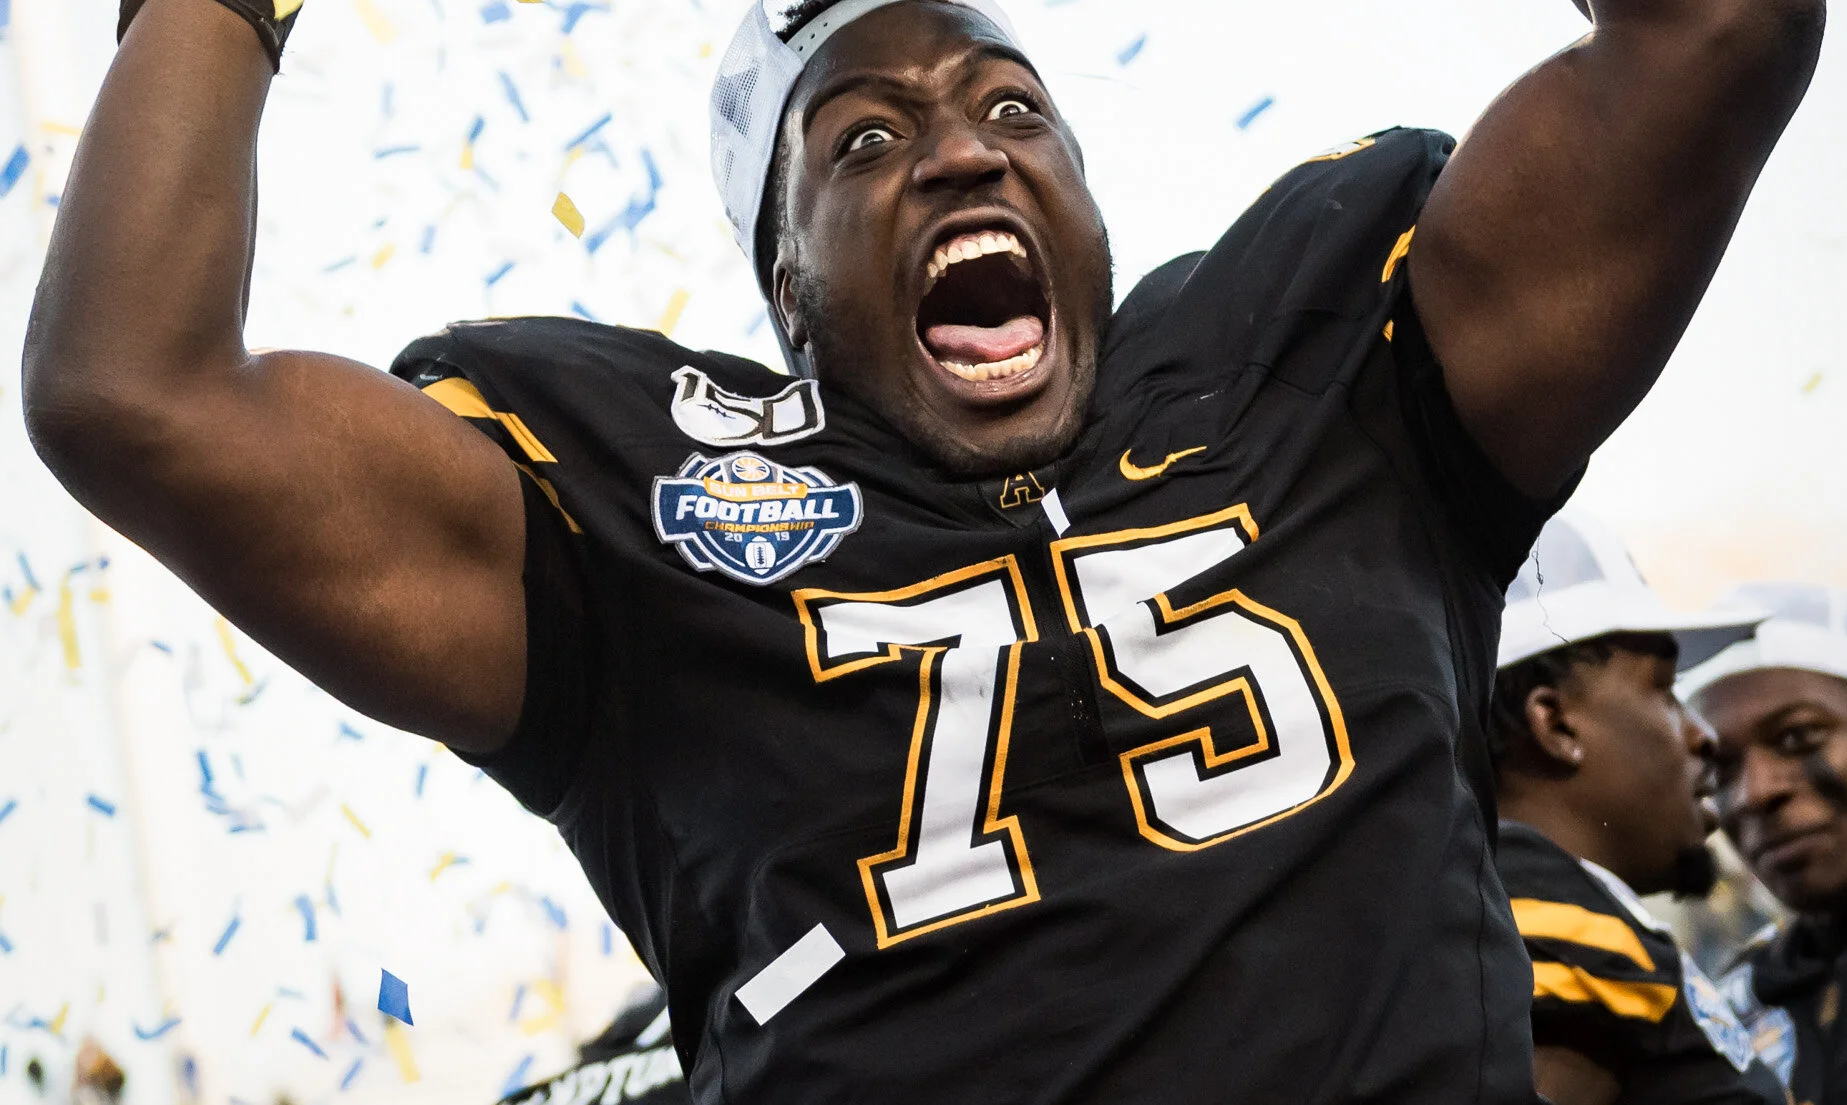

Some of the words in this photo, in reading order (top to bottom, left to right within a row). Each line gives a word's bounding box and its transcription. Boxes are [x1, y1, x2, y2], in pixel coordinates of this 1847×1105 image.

[708, 482, 748, 498] SUN
[751, 484, 800, 498] BELT
[675, 494, 840, 523] FOOTBALL
[704, 520, 815, 534] CHAMPIONSHIP
[724, 532, 743, 543] 20
[775, 532, 791, 543] 19
[791, 502, 1356, 950] 75
